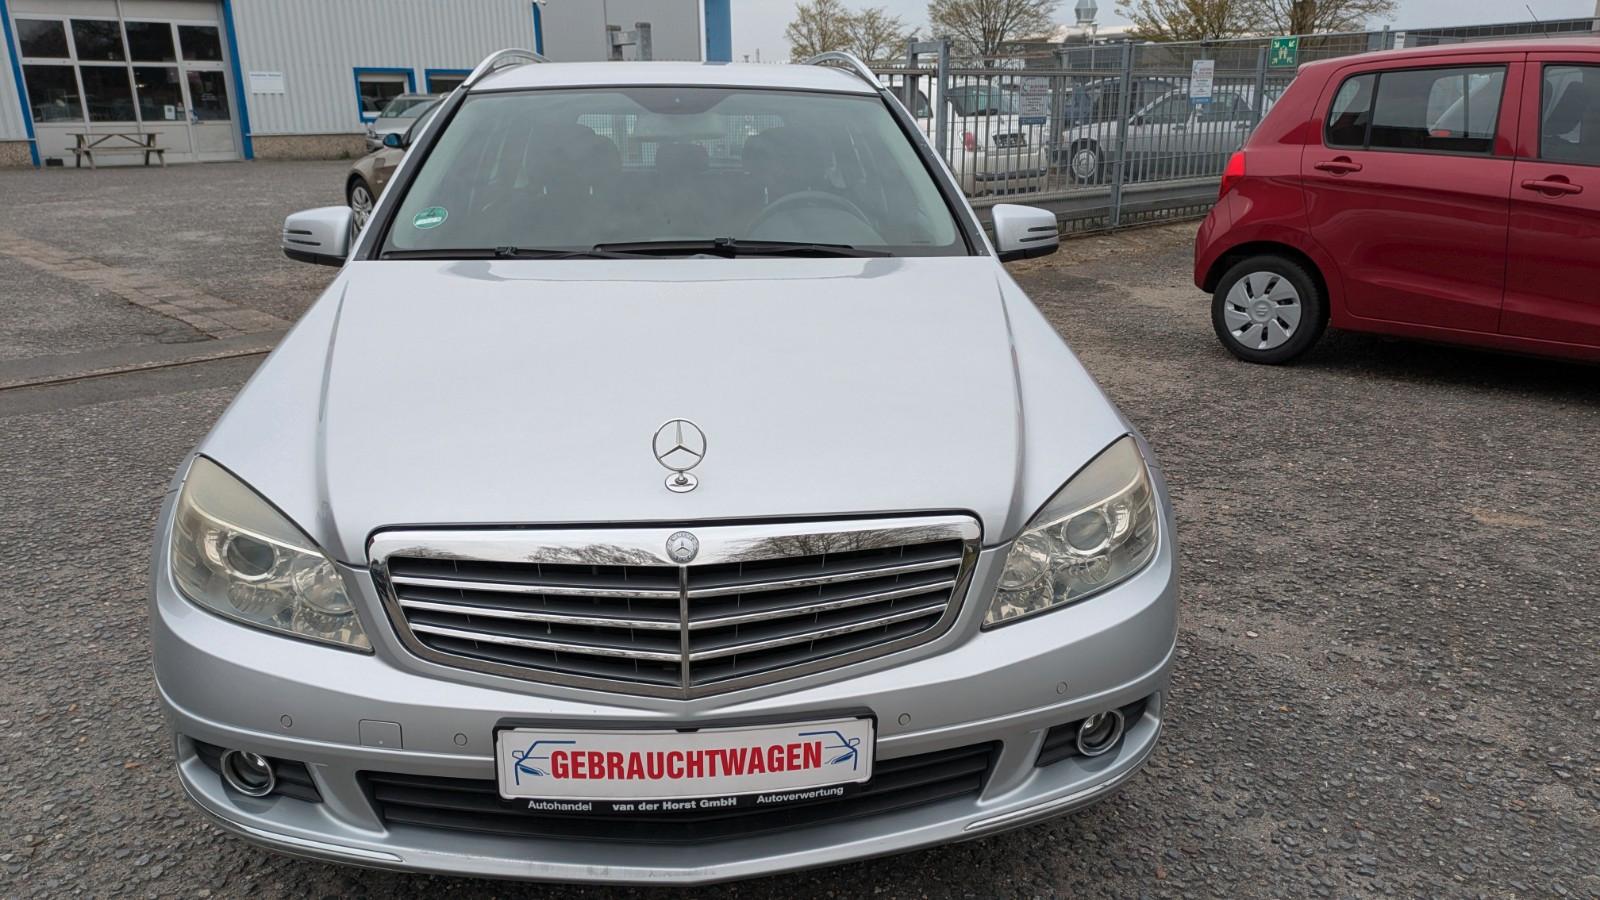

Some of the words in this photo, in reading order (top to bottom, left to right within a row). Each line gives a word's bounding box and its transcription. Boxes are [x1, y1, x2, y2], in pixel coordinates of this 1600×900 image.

[551, 741, 822, 780] GEBRAUCHTWAGEN
[528, 800, 592, 811] Autohandel
[612, 803, 635, 811] van
[638, 801, 660, 811] der
[662, 800, 697, 810] Horst
[700, 797, 737, 808] GmbH
[756, 786, 844, 804] Autoverwertung
